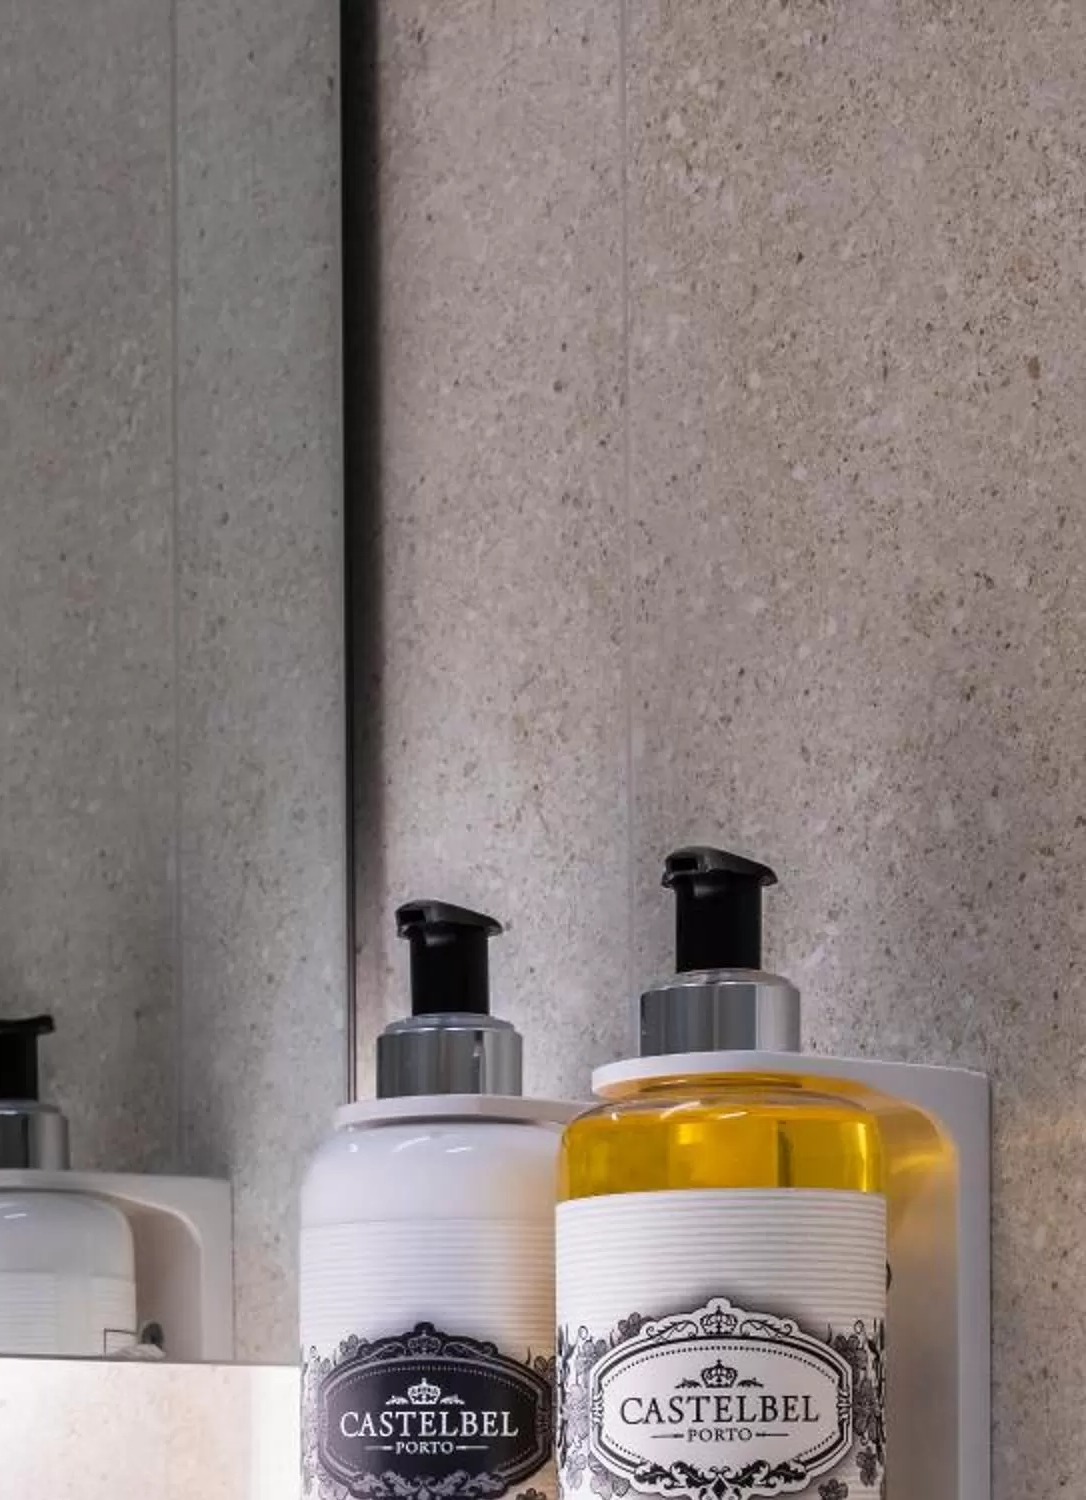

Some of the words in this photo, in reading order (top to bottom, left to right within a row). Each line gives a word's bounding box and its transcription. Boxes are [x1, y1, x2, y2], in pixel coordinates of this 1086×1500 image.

[620, 1395, 820, 1426] CASTELBEL
[340, 1411, 520, 1438] CASTELBEL
[687, 1427, 754, 1443] PORTO
[395, 1440, 454, 1455] PORTO
